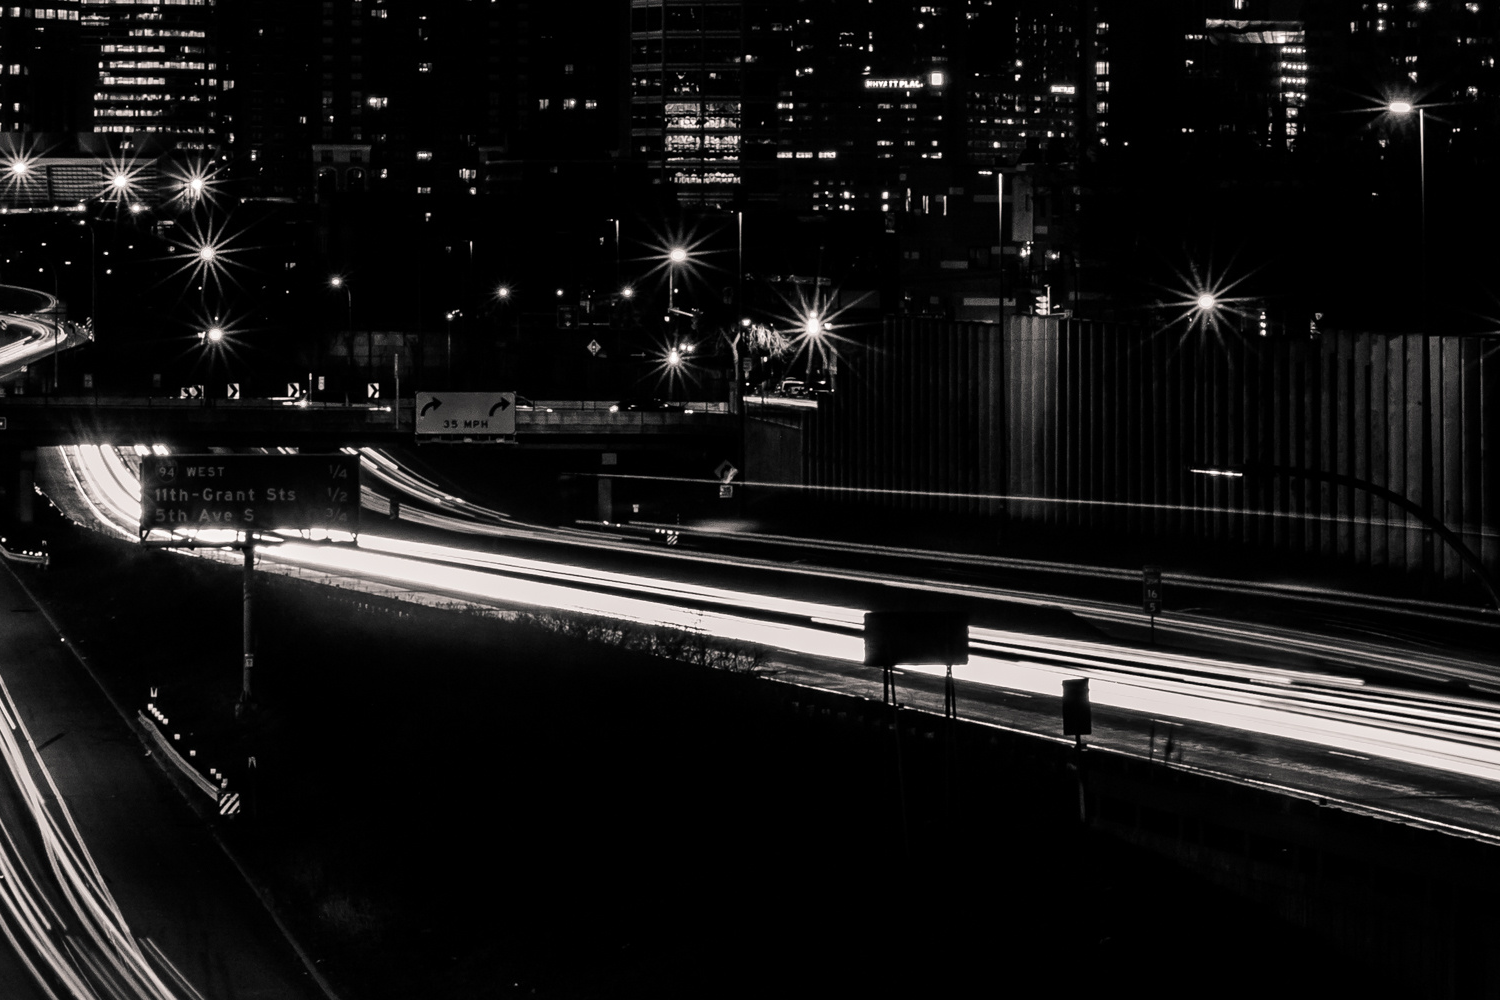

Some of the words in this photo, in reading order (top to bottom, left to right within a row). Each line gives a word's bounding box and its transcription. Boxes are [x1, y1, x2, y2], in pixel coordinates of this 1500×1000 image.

[443, 420, 458, 429] 35
[464, 420, 488, 429] MPH
[159, 467, 175, 477] 94
[186, 466, 225, 477] WEST
[154, 487, 256, 502] 11th-Grant
[266, 487, 297, 502] Sts
[155, 508, 188, 522] 5th
[199, 508, 233, 522] Ave
[243, 508, 255, 522] S
[1147, 589, 1158, 598] 16
[1149, 602, 1156, 612] 5
